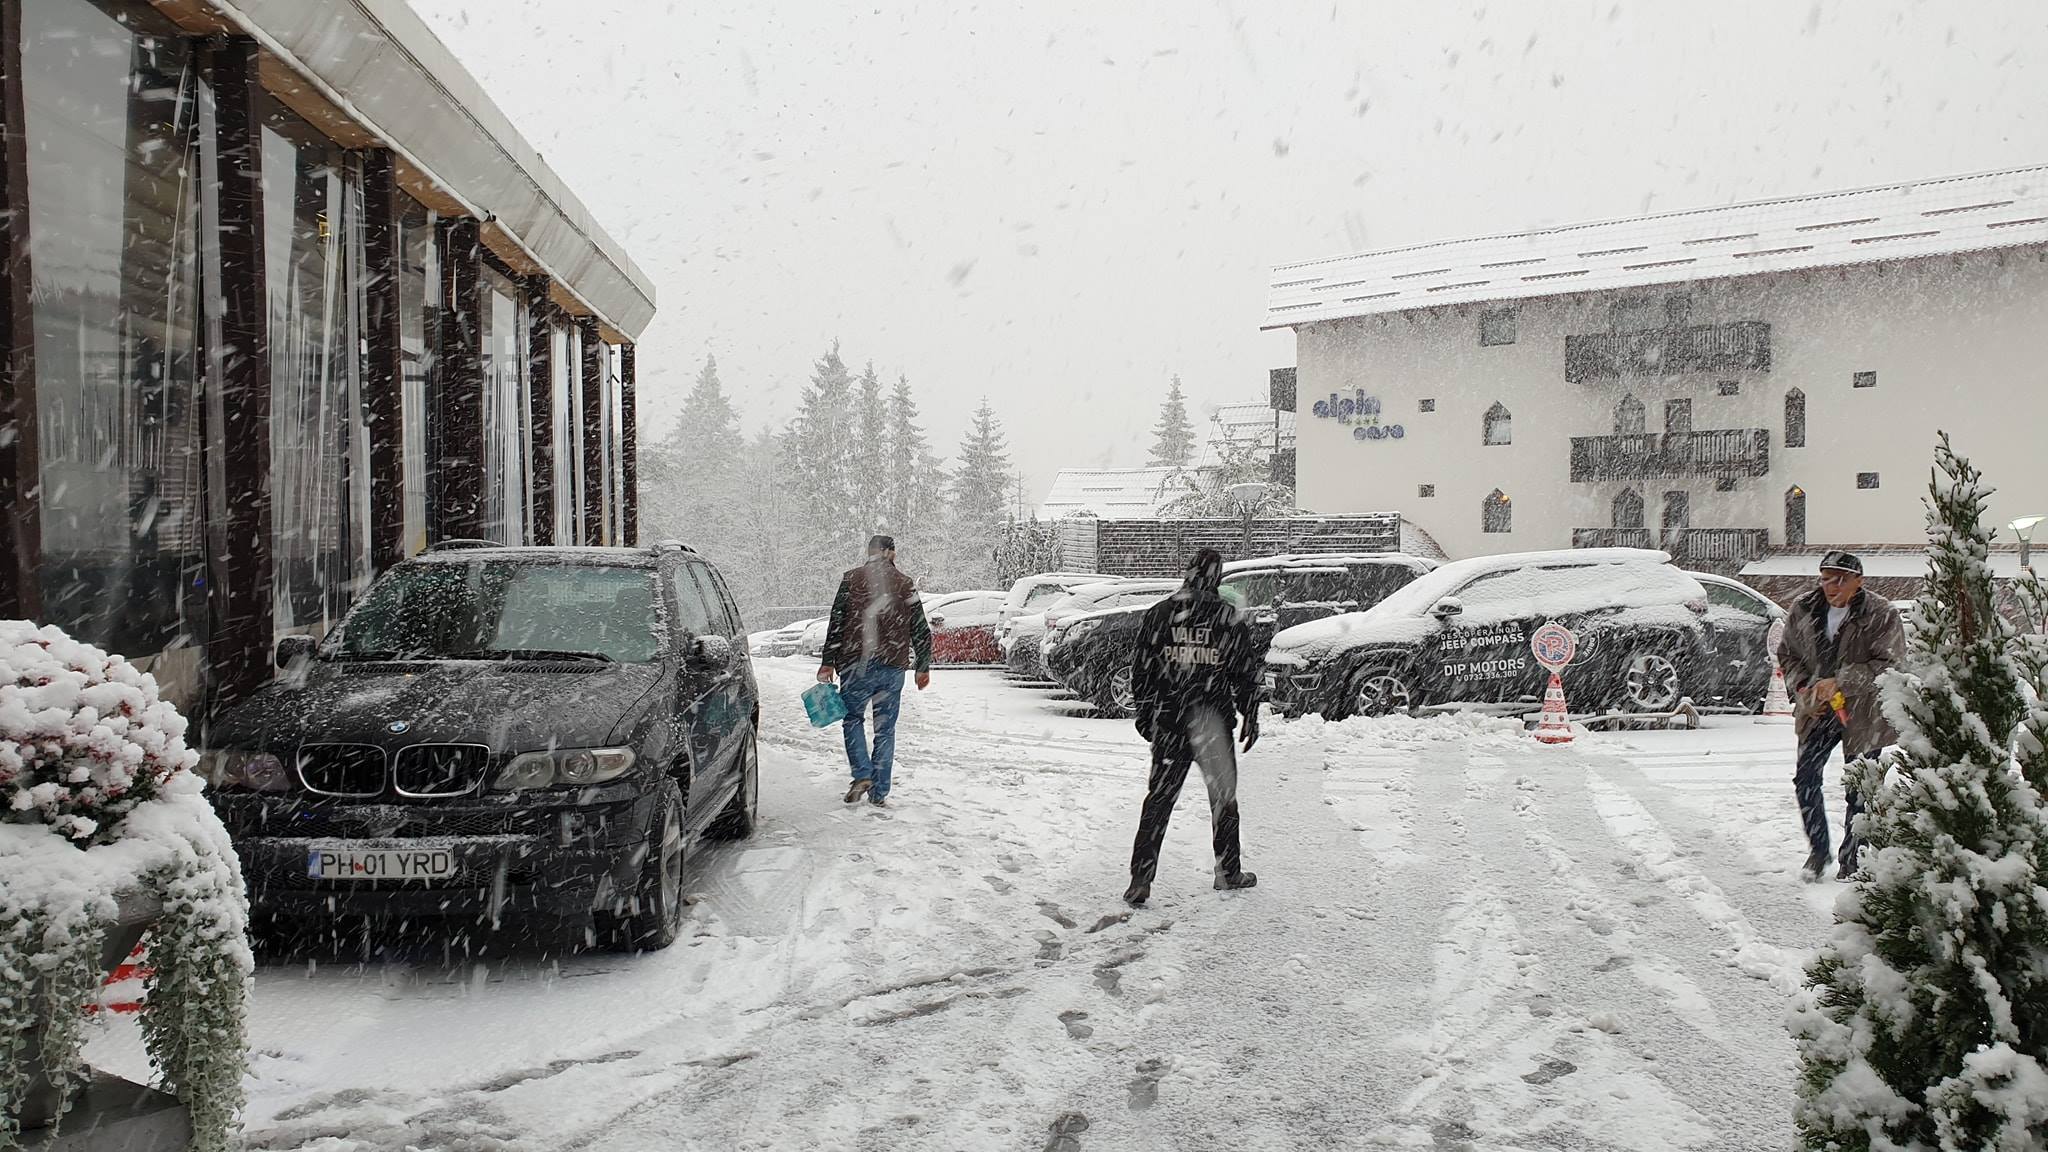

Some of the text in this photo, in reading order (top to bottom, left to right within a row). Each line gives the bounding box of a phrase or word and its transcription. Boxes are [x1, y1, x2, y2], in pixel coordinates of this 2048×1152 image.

[1312, 388, 1381, 424] alpin
[1171, 626, 1212, 644] VALET
[1440, 632, 1525, 650] JEEP COMPASS
[1164, 646, 1219, 665] PARKING
[1444, 657, 1526, 677] DIP MOTORS
[1463, 670, 1518, 682] 0732.336.300
[320, 852, 448, 875] PH 01 YRD
